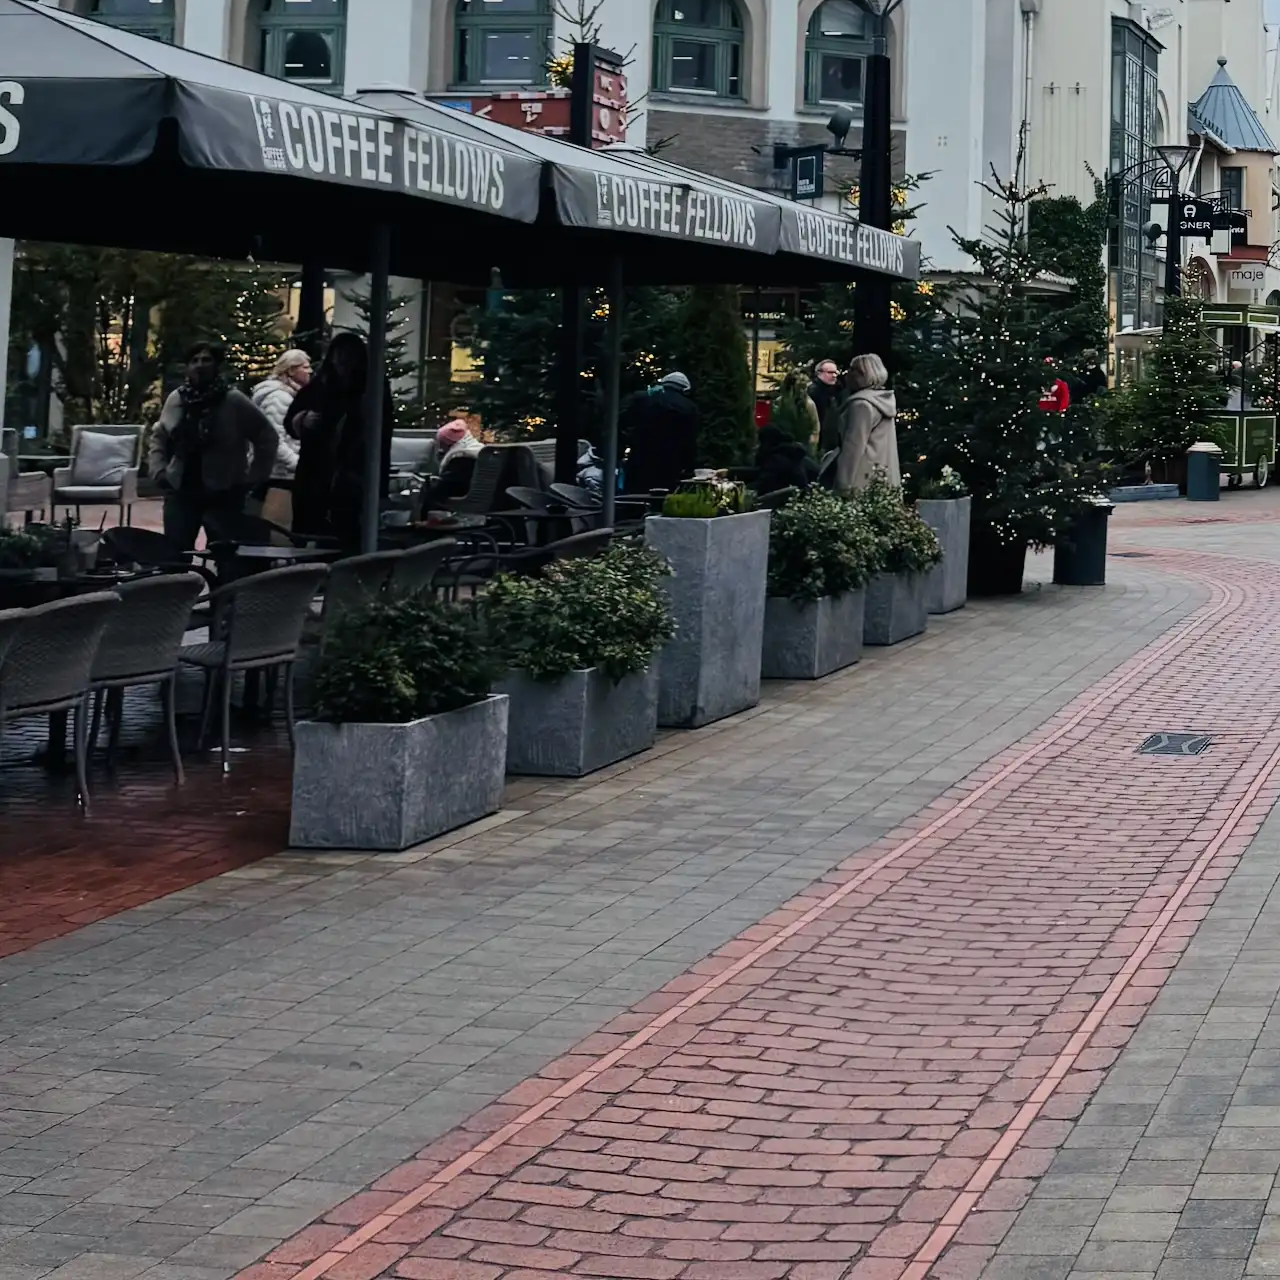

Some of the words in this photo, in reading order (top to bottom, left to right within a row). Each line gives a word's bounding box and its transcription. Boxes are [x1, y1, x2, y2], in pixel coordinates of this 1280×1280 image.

[278, 101, 394, 184] COFFEE
[403, 125, 505, 210] FELLOWS
[611, 176, 683, 234] COFFEE
[685, 189, 757, 247] FELLOWS
[1180, 221, 1211, 230] GNER
[806, 212, 855, 261] COFFEE
[856, 225, 904, 274] FELLOWS
[1231, 269, 1264, 281] maje
